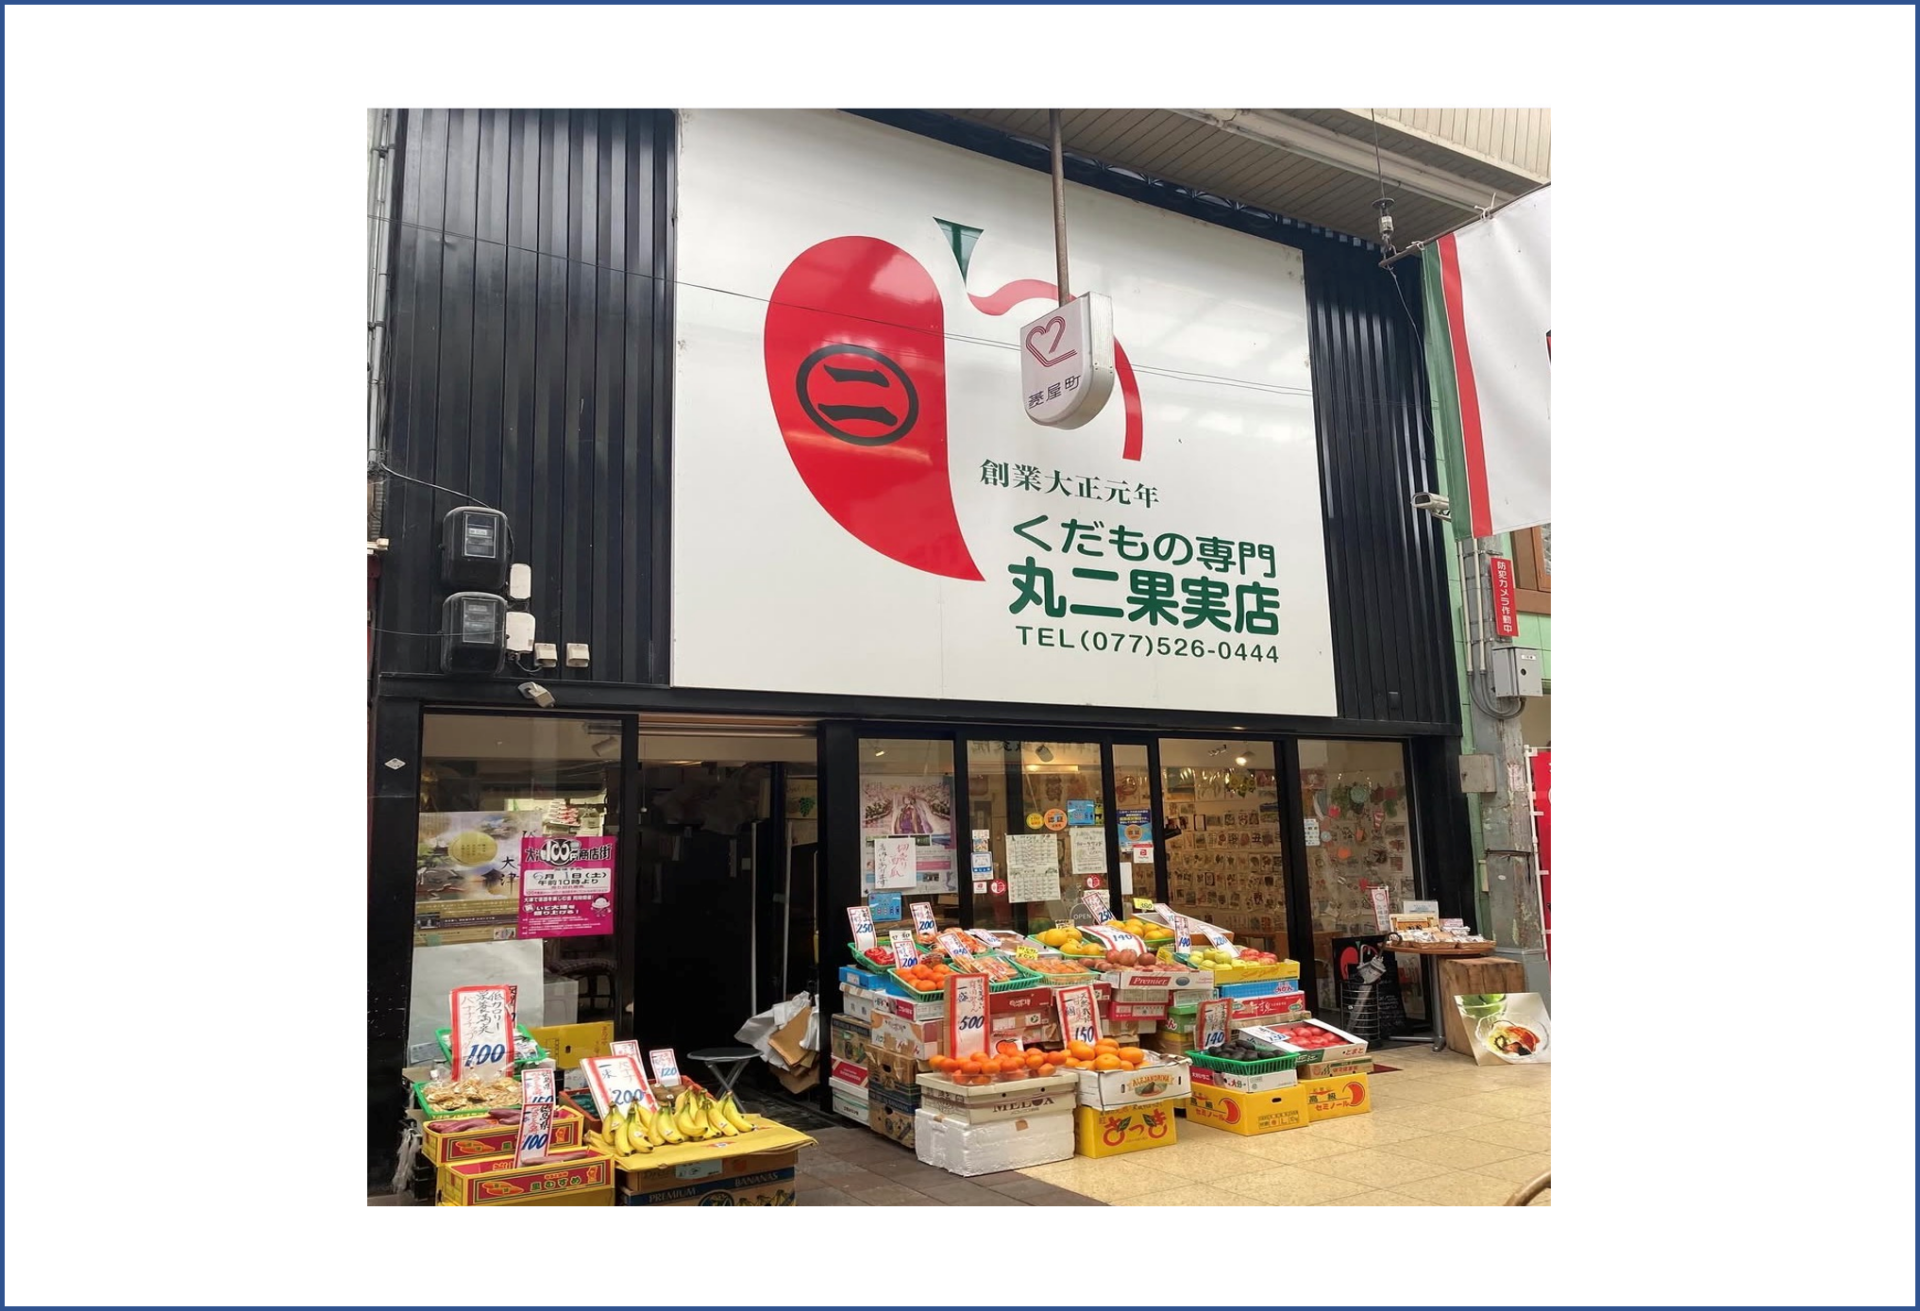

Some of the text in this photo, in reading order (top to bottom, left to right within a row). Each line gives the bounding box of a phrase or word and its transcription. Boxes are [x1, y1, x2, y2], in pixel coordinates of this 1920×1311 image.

[1028, 375, 1081, 409] 菱屋町
[979, 458, 1160, 508] 創業大正元年
[1012, 515, 1277, 579] くだもの専門
[1007, 556, 1280, 636] 丸二果実店
[1496, 561, 1514, 634] 防犯カメラ作動中
[1015, 625, 1280, 664] TEL(077)526-0444
[856, 923, 873, 934] 250
[959, 1015, 985, 1031] 500
[1075, 1025, 1095, 1043] 150
[1205, 1031, 1225, 1047] 140
[465, 1043, 506, 1067] 100
[611, 1088, 647, 1106] 200
[1315, 1100, 1350, 1112] セミノール
[521, 1133, 549, 1150] 100
[650, 1171, 779, 1205] PREMIUM BANANAS
